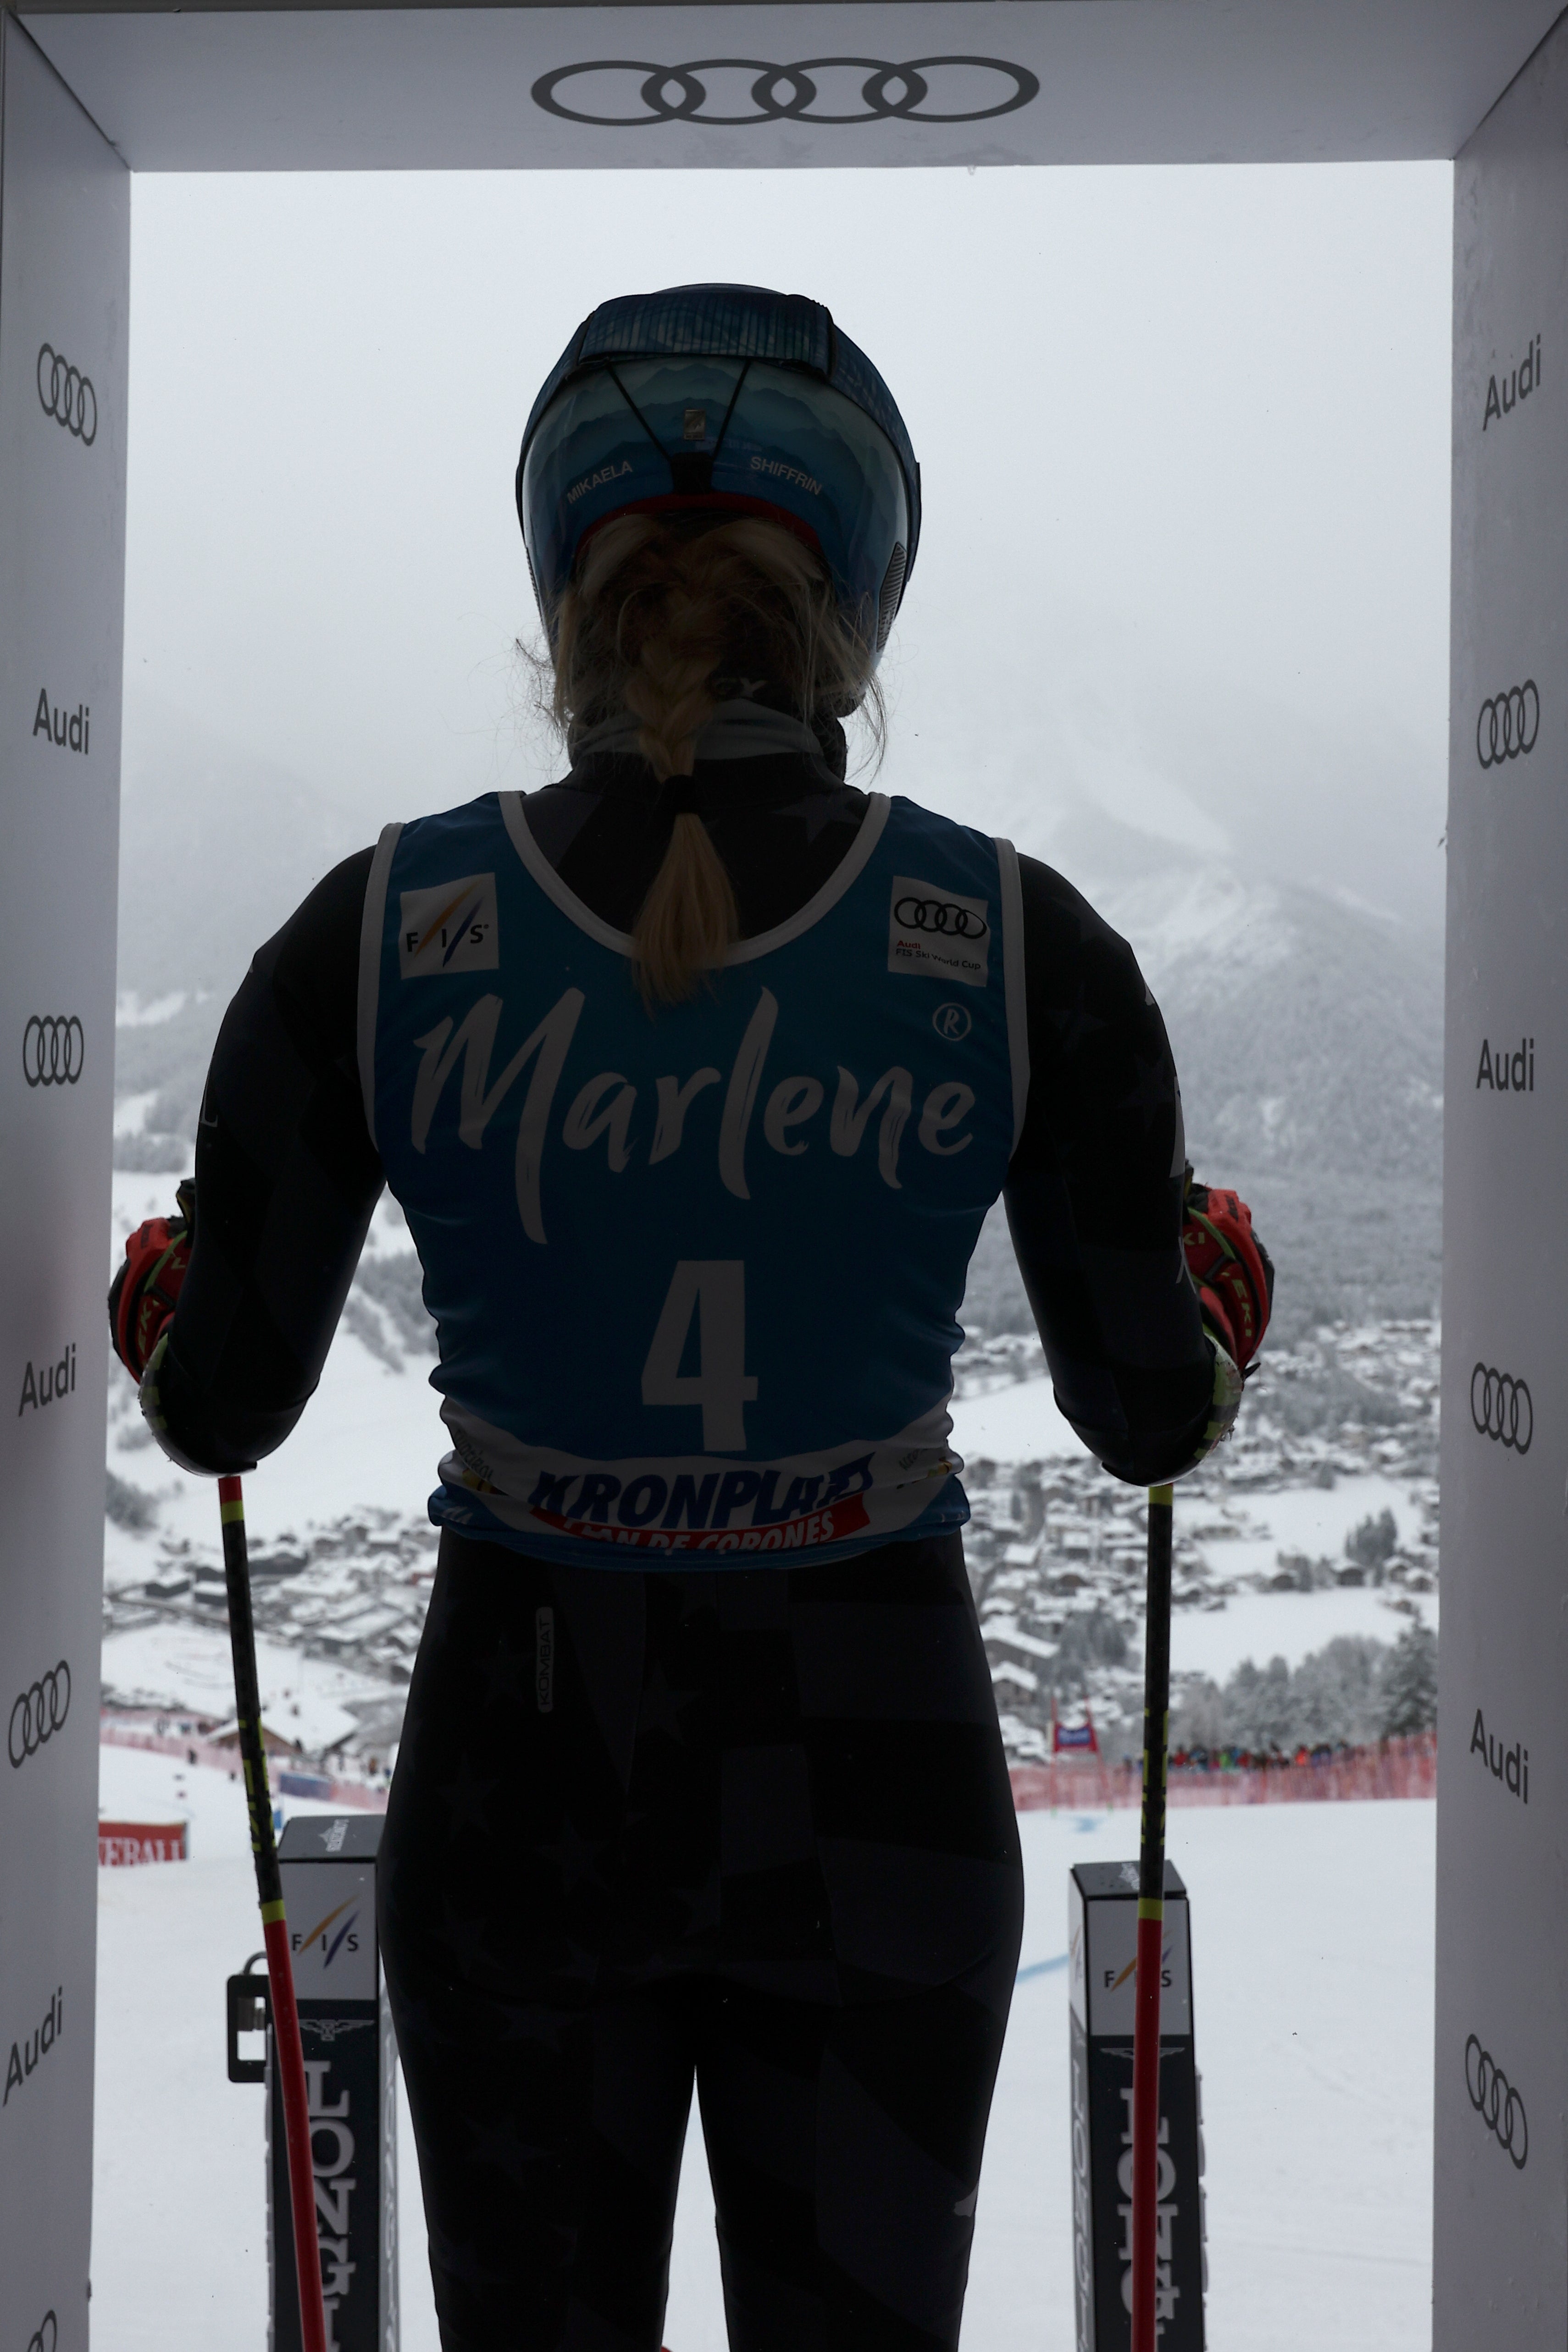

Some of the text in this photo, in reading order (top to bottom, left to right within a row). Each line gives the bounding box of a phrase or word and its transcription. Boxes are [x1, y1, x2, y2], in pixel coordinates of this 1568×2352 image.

[1483, 333, 1541, 431] Audi
[567, 456, 823, 504] MIKAELA SHIFFRIN
[33, 688, 89, 754] Audi
[406, 924, 483, 952] FIS
[896, 948, 981, 969] FIS Ski World Cup
[897, 941, 920, 949] Audi
[1476, 1038, 1535, 1091] Audi
[411, 985, 976, 1245] Marlene
[18, 1343, 76, 1417] Audi
[641, 1260, 759, 1452] 4
[539, 1615, 551, 1705] KOMBAT
[1470, 1709, 1528, 1804] Audi
[293, 1933, 358, 1951] FIS
[1104, 1970, 1172, 1987] FS
[3, 1986, 62, 2107] Audi
